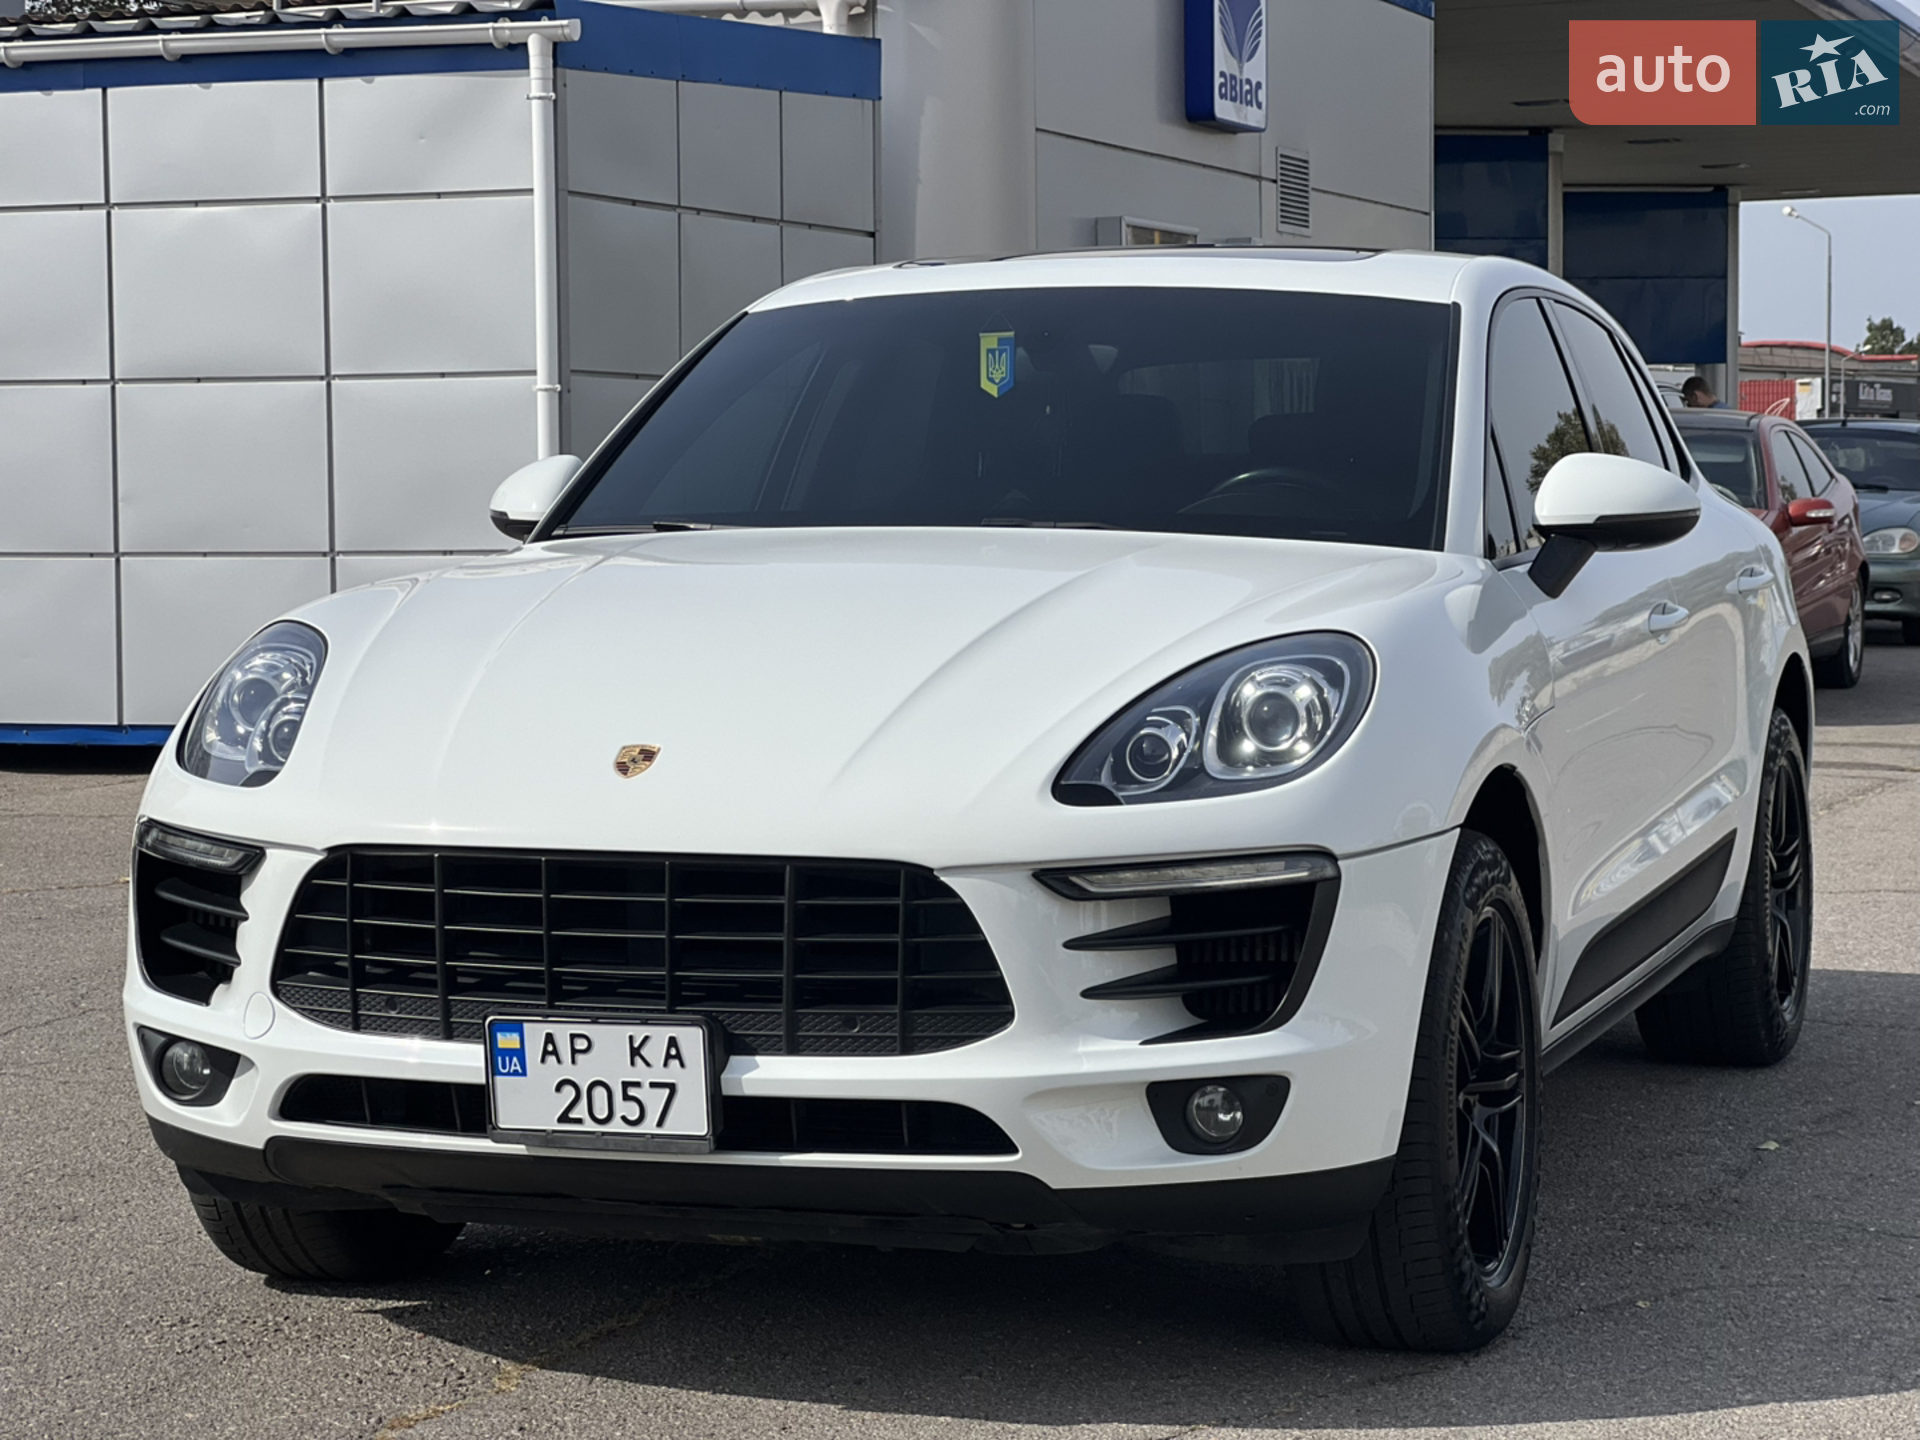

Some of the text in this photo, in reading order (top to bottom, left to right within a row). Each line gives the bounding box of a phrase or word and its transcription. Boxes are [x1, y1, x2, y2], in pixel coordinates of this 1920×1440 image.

[498, 1056, 523, 1074] UA
[539, 1031, 686, 1069] AP KA
[554, 1078, 678, 1128] 2057
